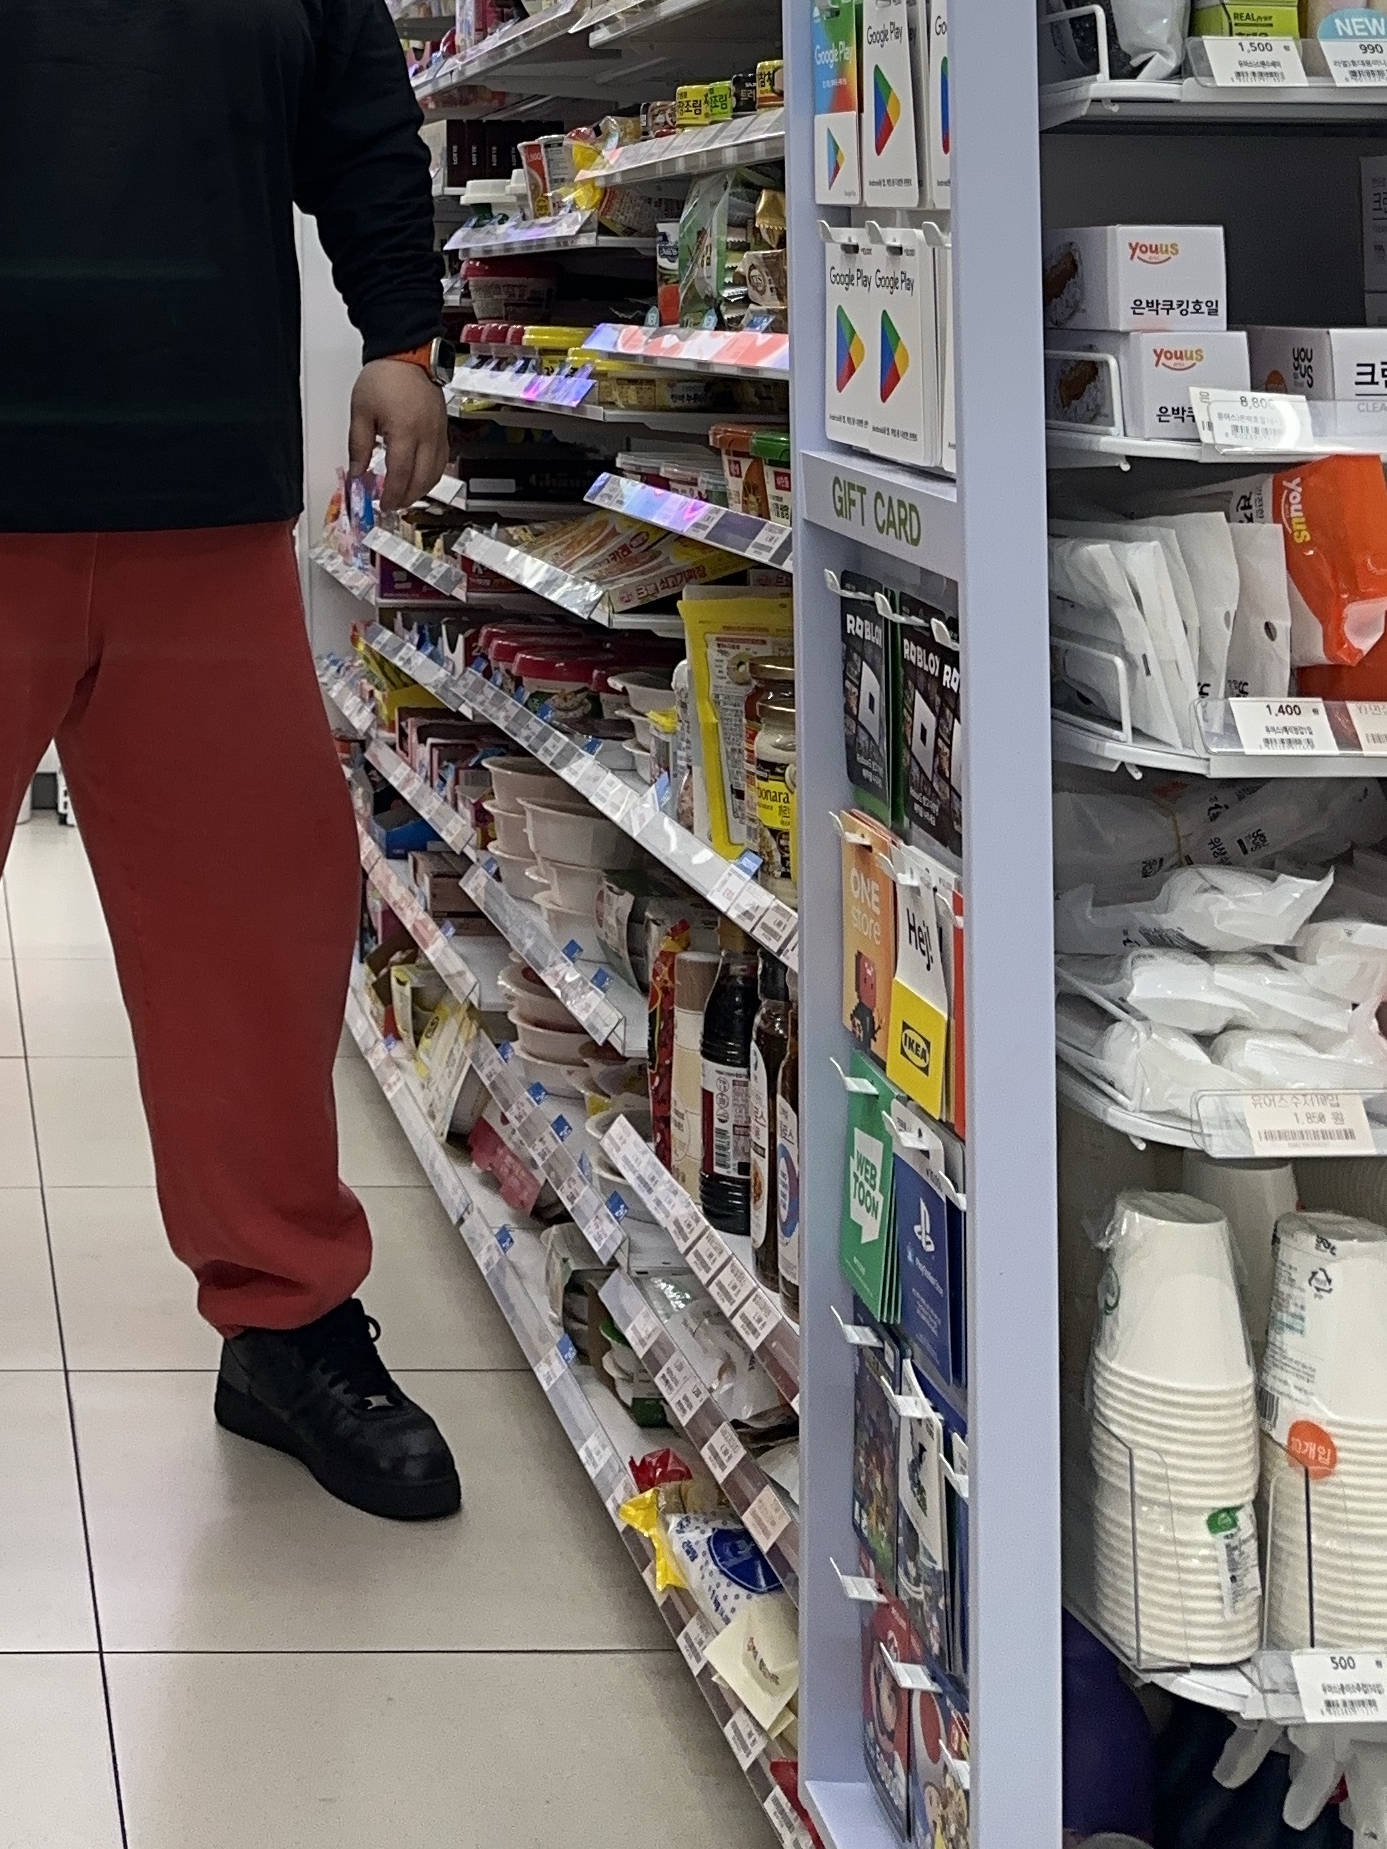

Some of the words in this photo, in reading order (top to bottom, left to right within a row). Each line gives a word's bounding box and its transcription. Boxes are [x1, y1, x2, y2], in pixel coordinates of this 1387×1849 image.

[1233, 12, 1256, 21] REAL
[1334, 17, 1387, 37] NEW
[867, 24, 889, 48] Google
[890, 21, 903, 44] Play
[1238, 41, 1273, 53] 1,500
[814, 41, 839, 69] Google
[839, 40, 853, 64] Play
[1359, 43, 1384, 55] 990
[1128, 241, 1180, 262] youus
[829, 265, 855, 293] Google
[856, 267, 873, 293] Play
[874, 268, 900, 296] Google
[900, 270, 915, 297] Play
[1130, 299, 1219, 317] 은박쿠킹호일
[1153, 347, 1204, 368] youus
[831, 475, 868, 527] GIFT
[873, 490, 922, 548] CARD
[1282, 476, 1312, 544] youus
[1265, 704, 1302, 717] 1,400
[849, 867, 881, 917] ONE
[851, 907, 882, 946] store
[906, 907, 934, 972] Hej!
[903, 1033, 929, 1064] IKEA
[856, 1150, 877, 1193] WEB
[853, 1171, 879, 1220] TOON
[1330, 1656, 1356, 1670] 500
